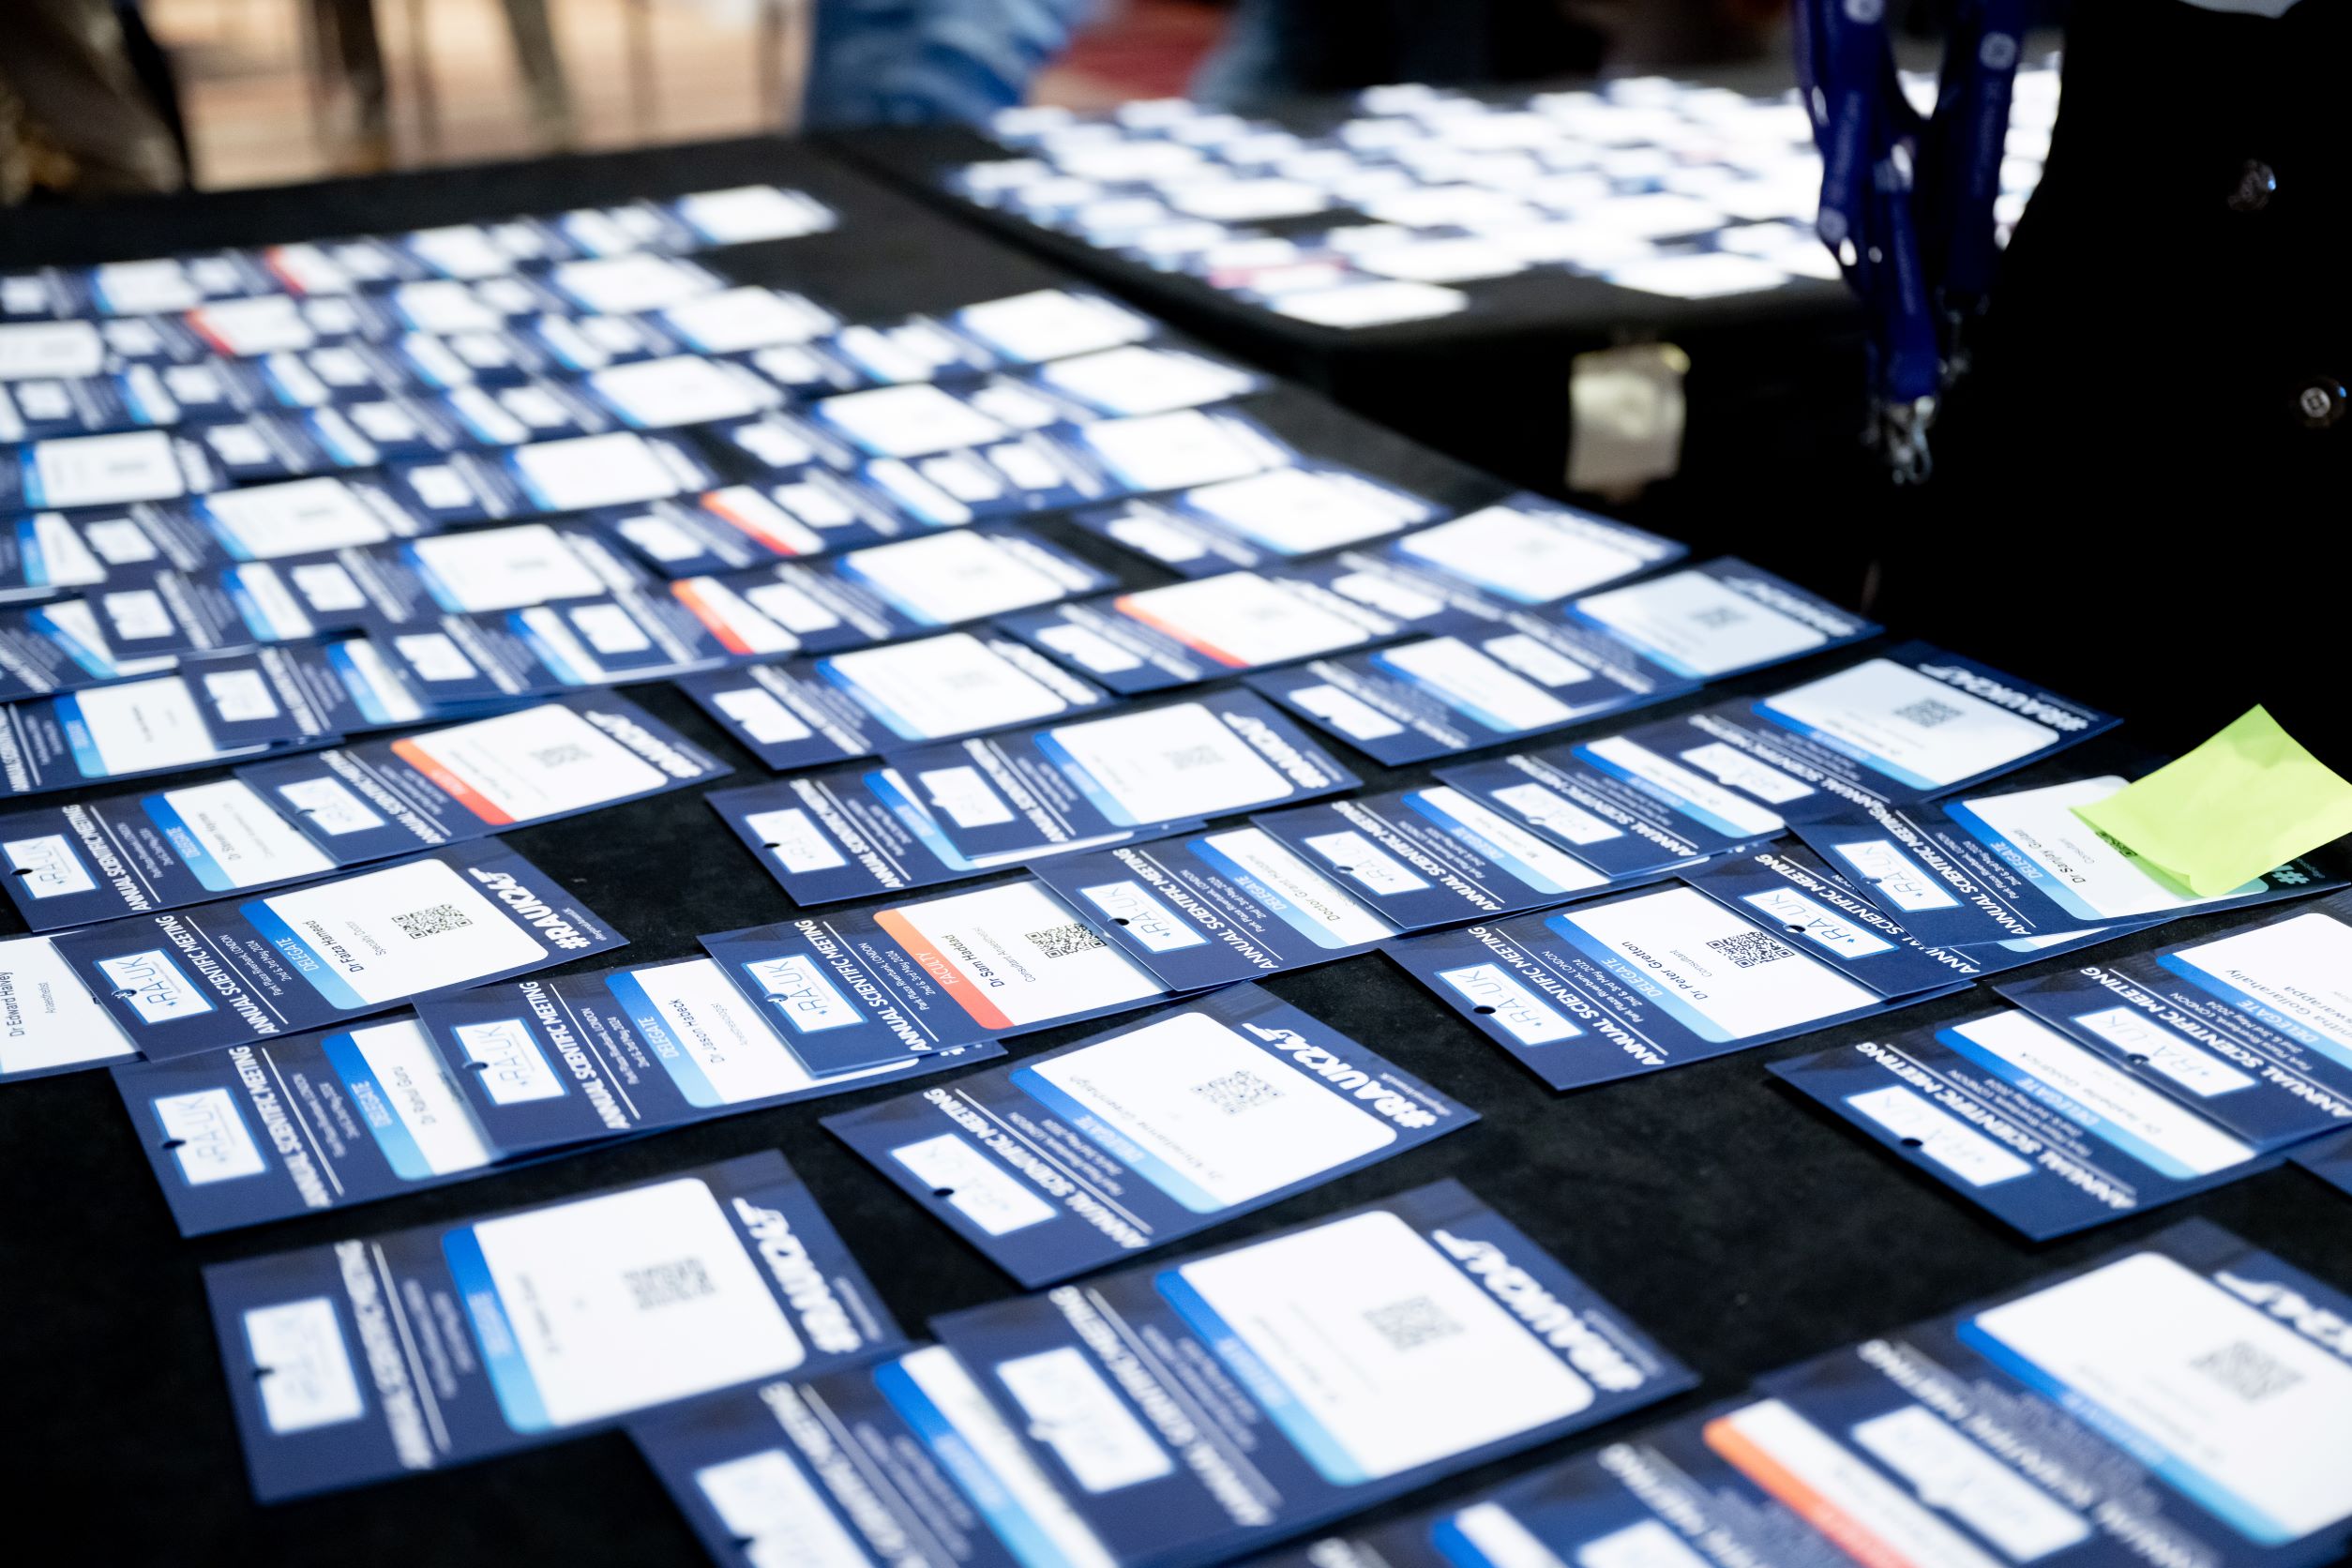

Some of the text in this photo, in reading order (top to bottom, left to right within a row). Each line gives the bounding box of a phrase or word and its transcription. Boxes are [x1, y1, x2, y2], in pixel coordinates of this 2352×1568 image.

[84, 837, 127, 877] SCIENTIFIC
[1629, 823, 1696, 856] ANNUAL
[2056, 837, 2097, 864] Consultant
[1753, 853, 1829, 892] MEETING
[1853, 846, 1926, 893] RA-UK
[1868, 807, 2031, 935] ANNUAL SCIENTIFIC MEETING
[1979, 854, 1999, 864] May
[1990, 864, 2007, 872] 3rd
[1993, 843, 2045, 879] DELEGATE
[2037, 849, 2076, 872] Sanjay
[112, 876, 152, 912] ANNUAL
[1235, 877, 1288, 911] DELEGATE
[1275, 878, 1309, 897] Grant
[1439, 875, 1500, 911] ANNUAL
[1987, 876, 2009, 888] Plaza
[2002, 889, 2021, 898] Park
[2006, 877, 2023, 886] 2nd
[2066, 873, 2087, 882] Dr
[487, 872, 591, 949] #RAUK24
[1097, 887, 1171, 933] RA-UK
[1112, 849, 1277, 969] ANNUAL SCIENTIFIC MEETING
[1231, 910, 1253, 922] Plaza
[1247, 922, 1266, 932] Park
[1249, 910, 1267, 919] 2nd
[1303, 897, 1342, 921] Doctor
[1760, 894, 1853, 941] RA-UK
[1819, 890, 1907, 935] SCIENTIFIC
[245, 940, 263, 951] 2024
[255, 950, 274, 960] May
[275, 937, 320, 971] DELEGATE
[301, 920, 365, 972] Dr Faiza Hameed
[341, 919, 389, 956] Specialty Doctor
[153, 914, 279, 1035] ANNUAL SCIENTIFIC MEETING
[218, 934, 283, 995] Park Plaza Riverbank, LONDON
[264, 959, 279, 968] 3rd
[886, 952, 905, 964] 2024
[897, 963, 917, 973] May
[914, 950, 959, 985] FACULTY
[941, 934, 1005, 987] Dr Sam Haddad
[1002, 955, 1037, 982] Consultant
[1575, 960, 1598, 973] 2024
[1618, 941, 1709, 1000] Dr Peter Gretton
[1667, 948, 1714, 977] Consultant
[115, 956, 178, 1003] RA-UK
[275, 972, 291, 981] 2nd
[765, 962, 830, 1012] RA-UK
[794, 920, 931, 1051] ANNUAL SCIENTIFIC MEETING
[859, 943, 930, 1011] Park Plaza Riverbank, LONDON
[907, 973, 923, 982] 3rd
[920, 987, 936, 996] 2nd
[1544, 952, 1646, 1022] Park Plaza Riverbank, LONDON
[1592, 972, 1615, 984] May
[1604, 958, 1666, 998] DELEGATE
[1606, 983, 1624, 992] 3rd
[2226, 970, 2311, 1015] Gollarahally
[6, 997, 23, 1027] Edward
[38, 982, 57, 1014] Anaesthetist
[1457, 972, 1544, 1025] RA-UK
[1466, 926, 1664, 1065] ANNUAL SCIENTIFIC MEETING
[1625, 997, 1645, 1007] 2nd
[2171, 994, 2218, 1018] LONDON
[2208, 1003, 2236, 1017] 2024
[9, 1028, 25, 1037] Dr
[581, 1008, 606, 1032] LONDON
[608, 1018, 625, 1031] 2024
[666, 998, 726, 1063] Dr Jason Habeck
[2238, 1002, 2317, 1044] DELEGATE
[474, 1025, 532, 1082] RA-UK
[519, 981, 630, 1131] ANNUAL SCIENTIFIC MEETING
[639, 1018, 680, 1059] DELEGATE
[2079, 966, 2352, 1117] ANNUAL SCIENTIFIC MEETING
[229, 1045, 273, 1095] MEETING
[1274, 1030, 1439, 1128] #RAUK24
[1857, 1042, 1947, 1093] MEETING
[386, 1065, 436, 1124] Dr Rahul Guru
[253, 1093, 303, 1154] SCIENTIFIC
[924, 1088, 1002, 1138] MEETING
